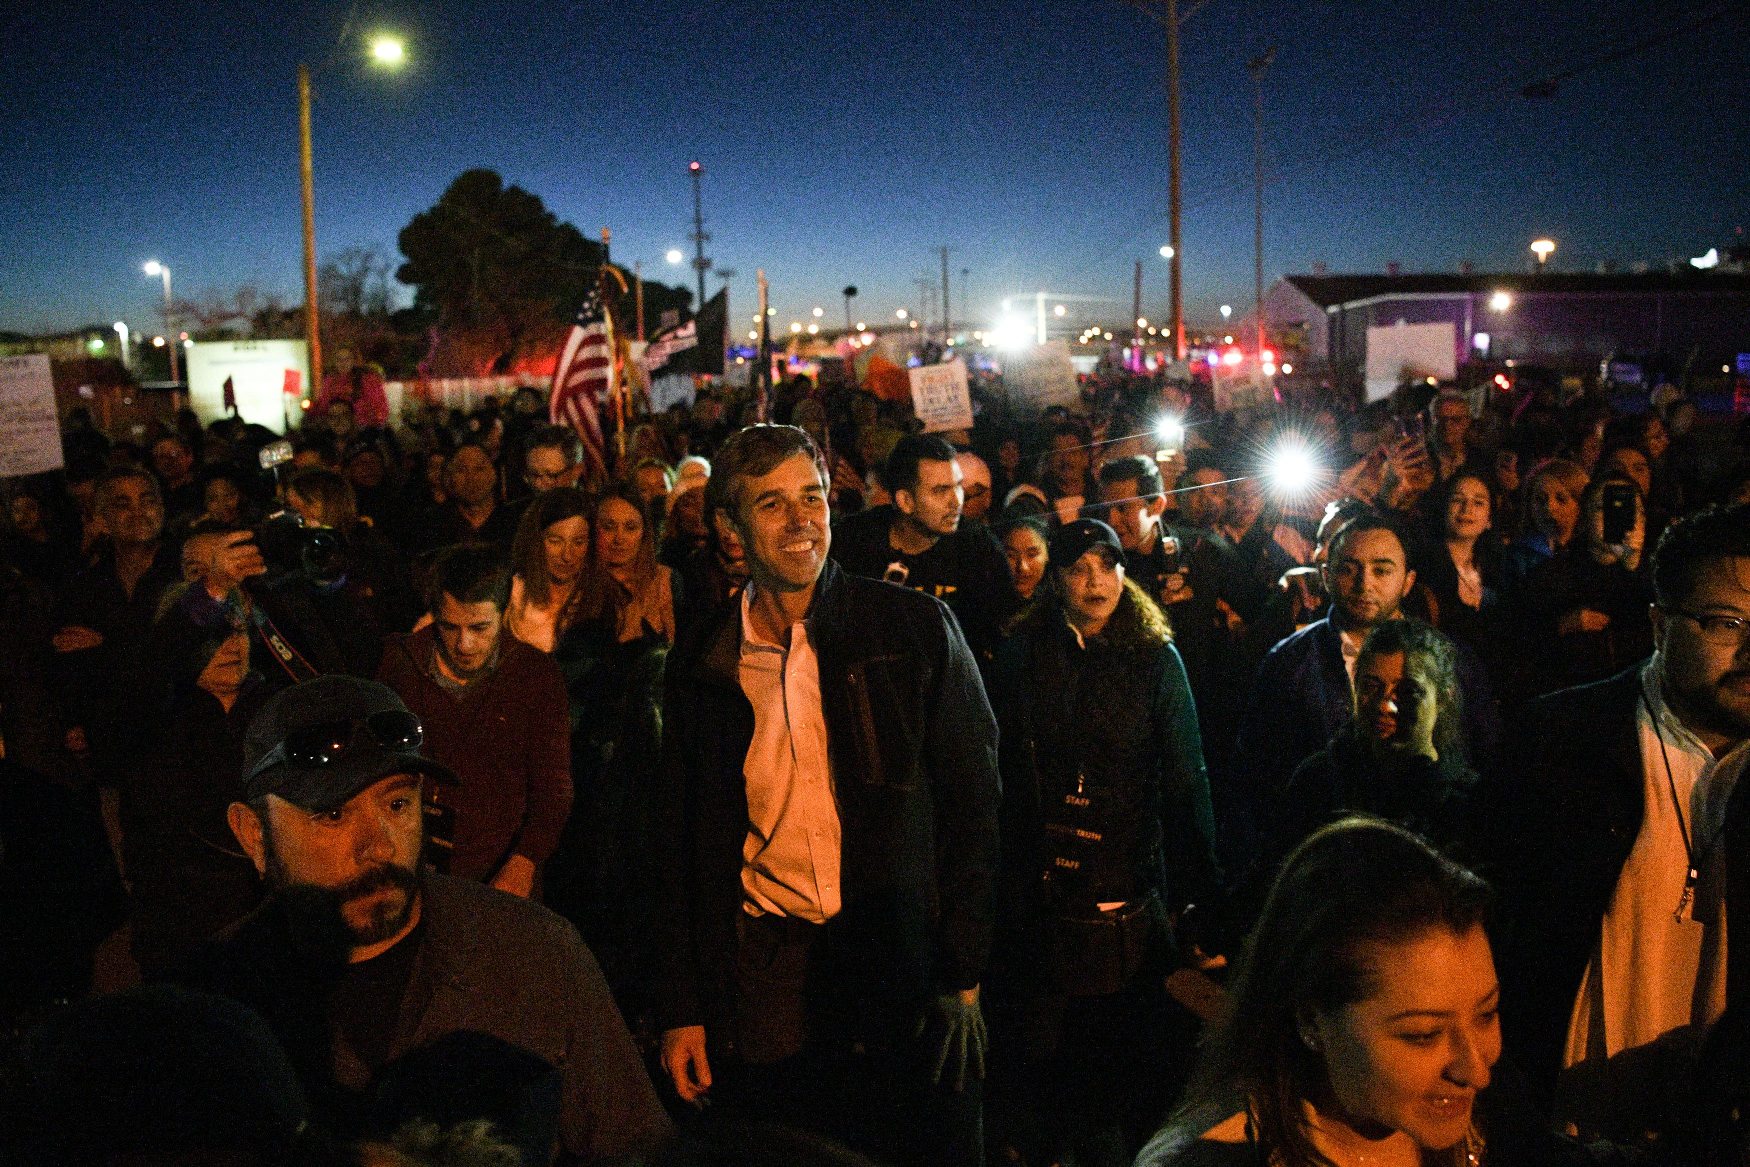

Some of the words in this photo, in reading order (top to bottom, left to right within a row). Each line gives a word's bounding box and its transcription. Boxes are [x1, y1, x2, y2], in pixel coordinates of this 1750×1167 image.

[270, 634, 293, 661] EOS
[1065, 794, 1090, 807] STAFF
[1055, 856, 1080, 870] STAFF
